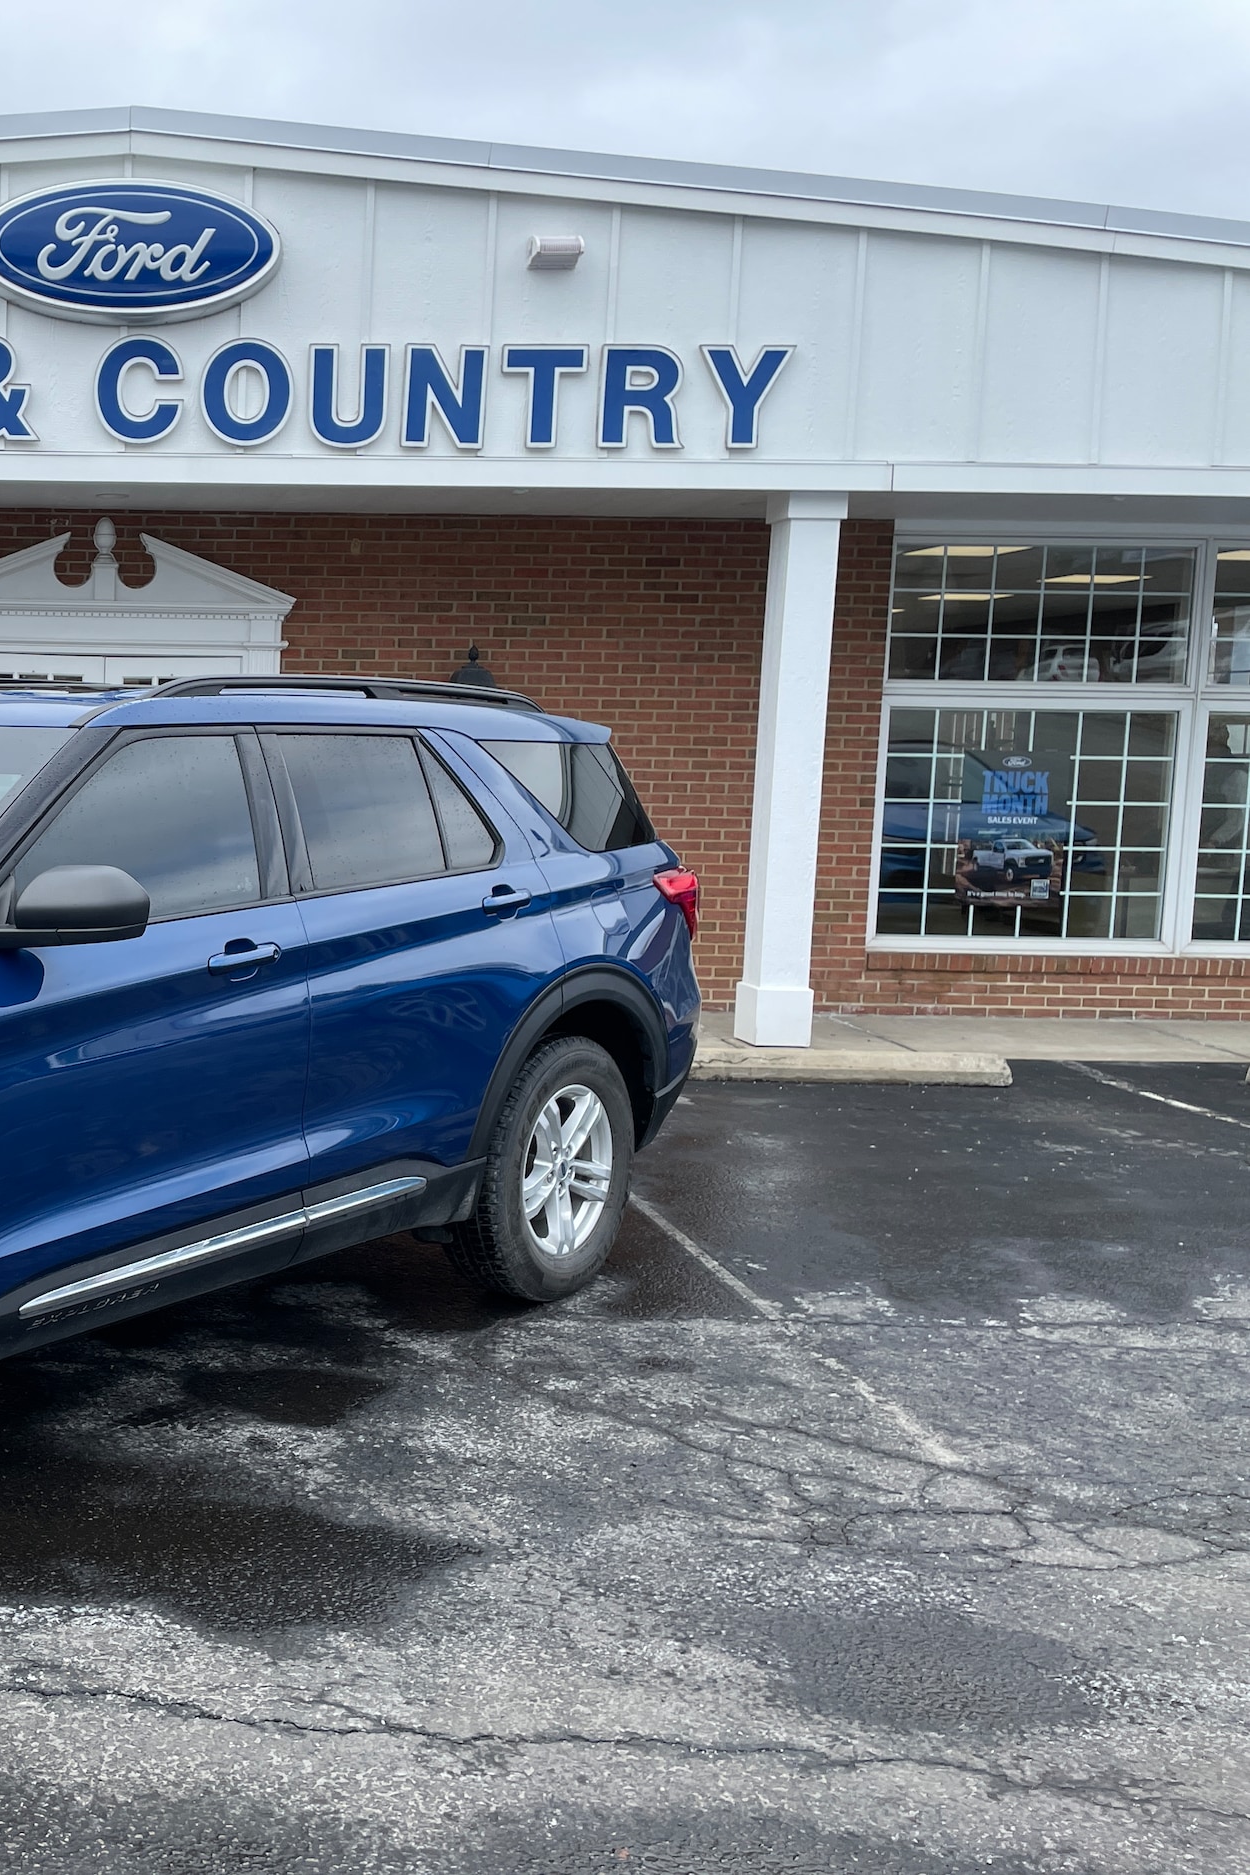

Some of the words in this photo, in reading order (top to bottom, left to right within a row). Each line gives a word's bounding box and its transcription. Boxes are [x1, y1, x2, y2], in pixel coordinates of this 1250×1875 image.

[37, 206, 216, 282] Ford
[95, 336, 796, 450] COUNTRY
[982, 770, 1049, 794] TRUCK
[981, 793, 1048, 815] MONTH
[987, 816, 1011, 824] SALES
[1012, 816, 1038, 824] EVENT
[25, 1283, 160, 1331] EXPLORER
